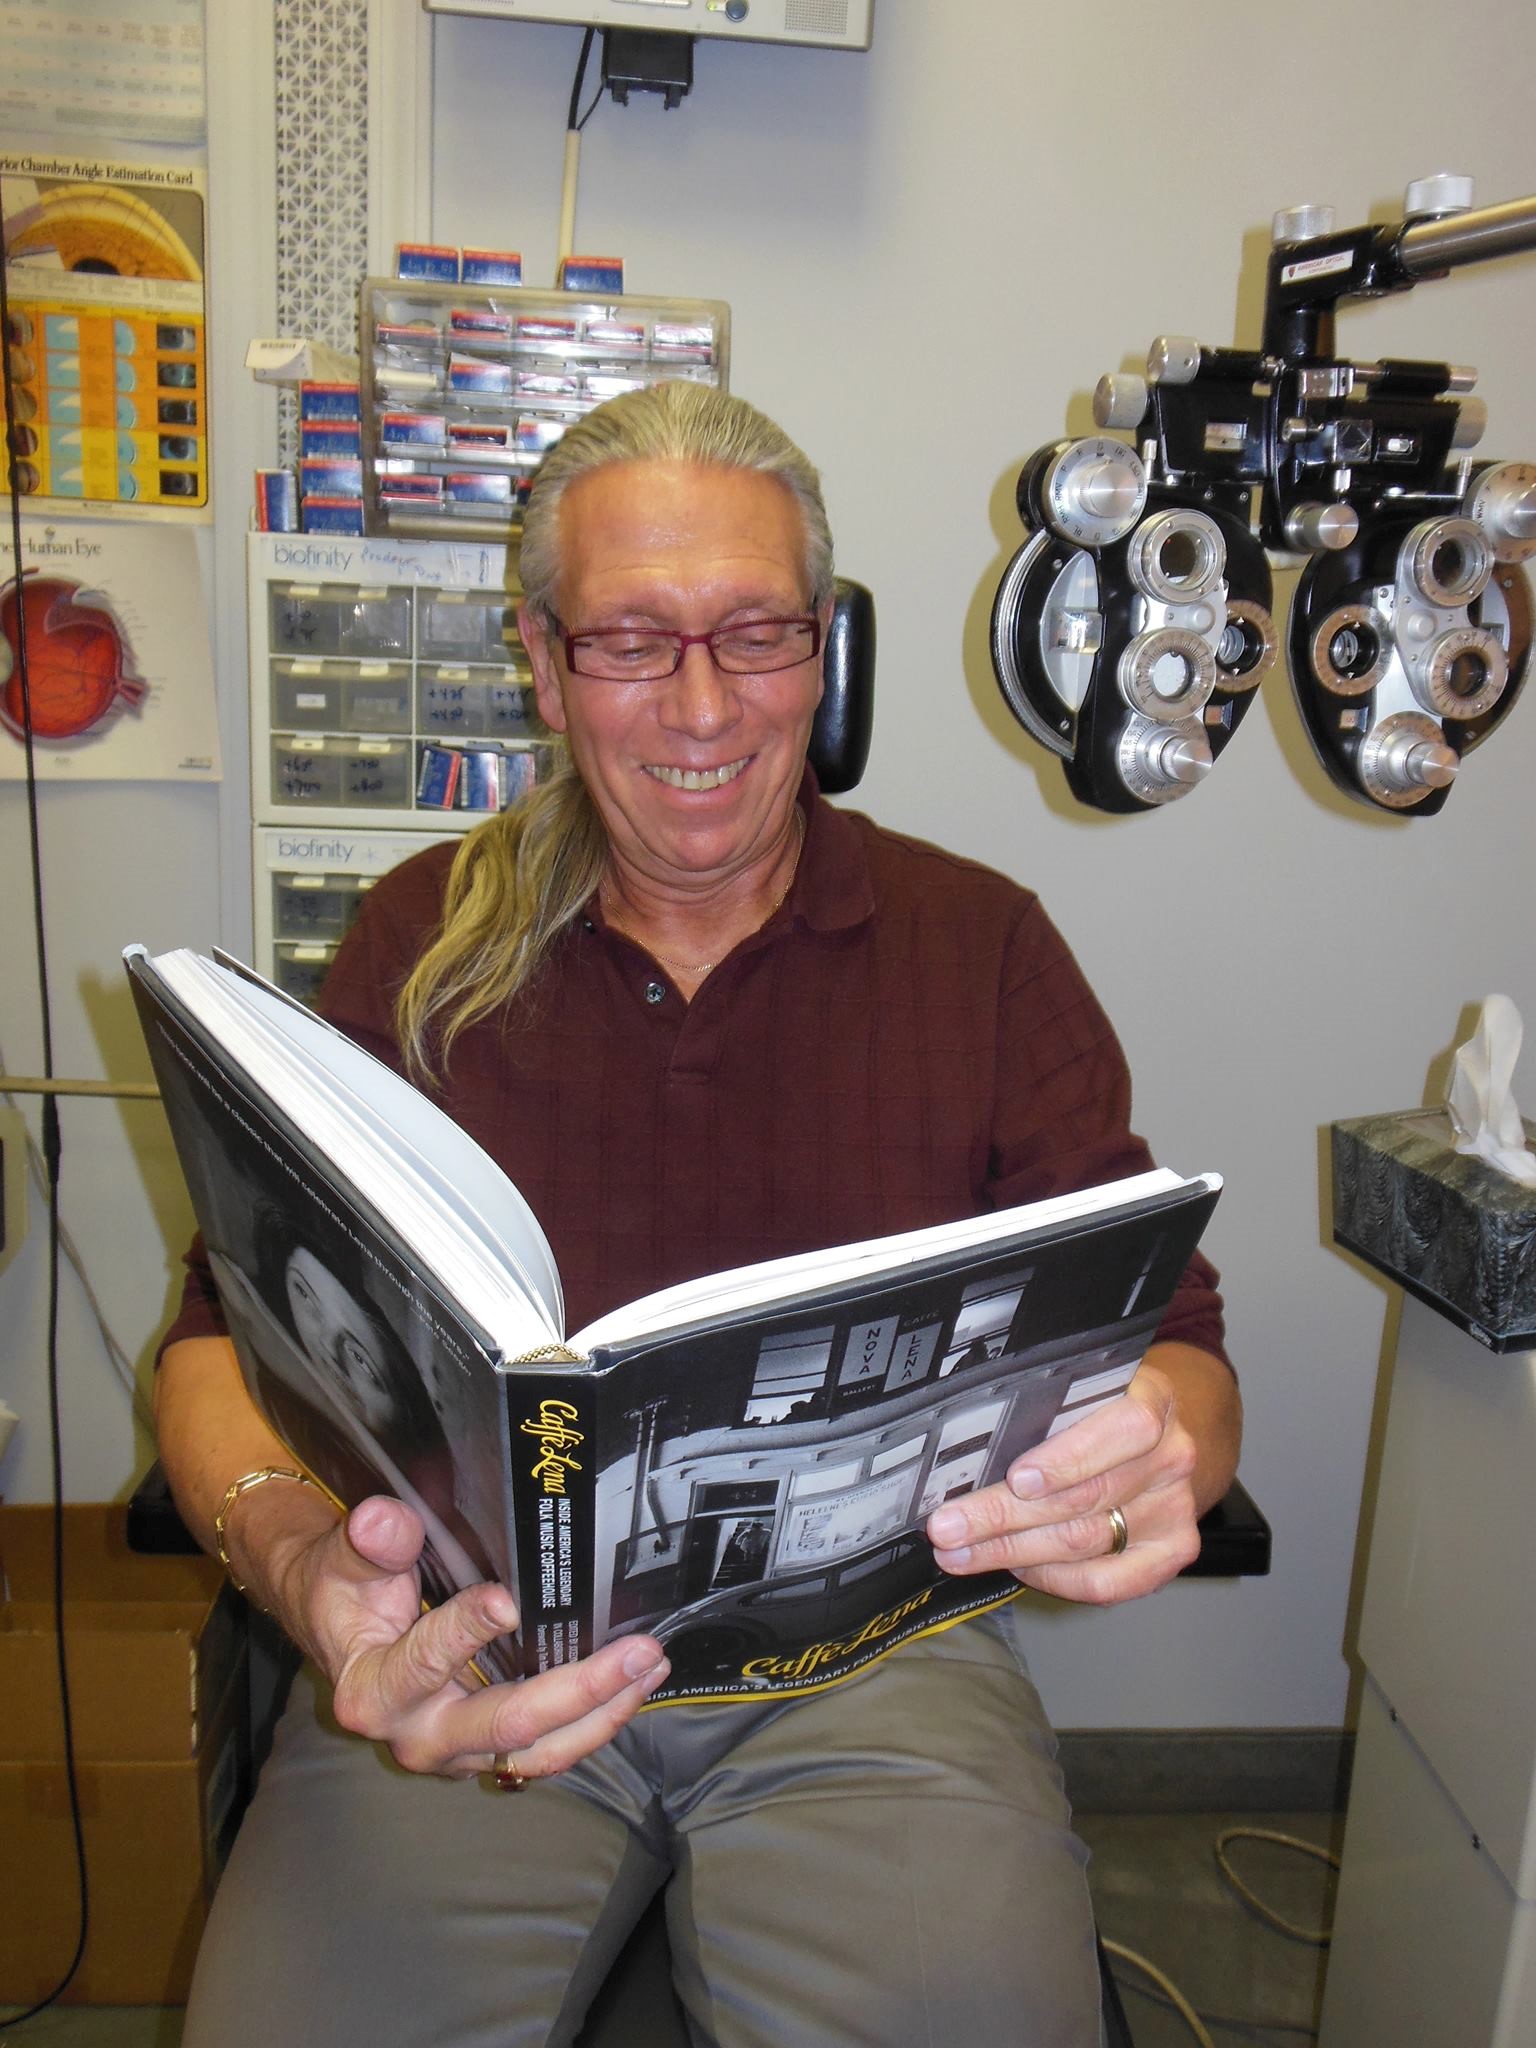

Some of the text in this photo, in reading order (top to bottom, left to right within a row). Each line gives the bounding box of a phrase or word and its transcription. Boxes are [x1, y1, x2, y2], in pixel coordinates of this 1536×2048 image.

[21, 157, 70, 175] Chamber
[73, 163, 103, 182] Angle
[106, 165, 164, 183] Estimation
[167, 171, 193, 185] Card
[274, 543, 353, 571] biofinity
[278, 837, 354, 863] biofinity
[299, 1182, 349, 1230] celebrate
[373, 1255, 414, 1301] through
[859, 1327, 881, 1375] NOVA
[901, 1334, 921, 1381] LENA
[531, 1452, 583, 1493] Lena
[539, 1498, 556, 1609] FOLK MUSIC COFFEEHOUSE
[558, 1498, 572, 1607] INSIDE AMERICA'S LEGENDARY
[680, 1683, 763, 1695] AMERICA'S
[767, 1664, 848, 1690] LEGENDARY
[853, 1647, 884, 1669] FOLK
[886, 1621, 926, 1649] MUSIC
[928, 1584, 1019, 1624] COFFEEHOUSE
[842, 1586, 933, 1656] Lena
